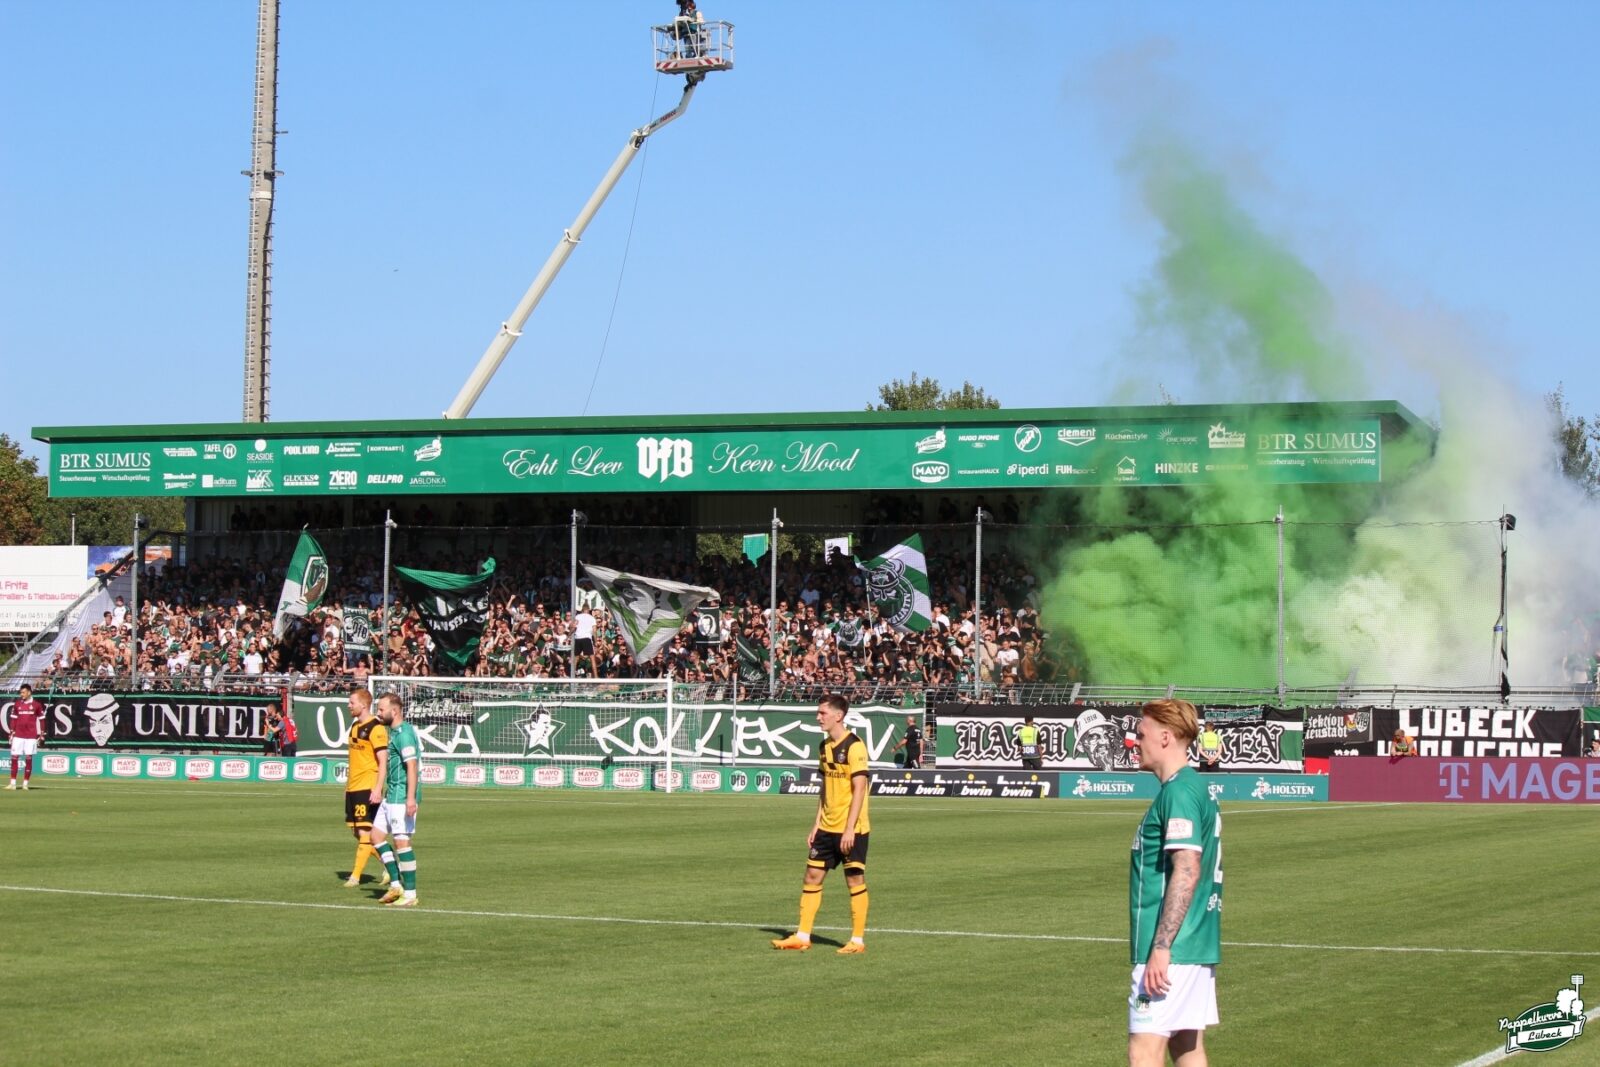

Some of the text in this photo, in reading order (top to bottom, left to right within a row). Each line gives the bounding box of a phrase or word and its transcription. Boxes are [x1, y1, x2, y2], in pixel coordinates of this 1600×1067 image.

[1257, 434, 1297, 450] BTR
[1303, 432, 1376, 450] SUMUS
[60, 454, 91, 468] BTR
[95, 452, 151, 468] SUMUS
[708, 442, 776, 474] Keen
[502, 449, 558, 479] Echt
[915, 466, 946, 475] MAYO
[1018, 463, 1049, 478] iperdi
[409, 477, 446, 485] JABLONKA
[788, 782, 821, 793] bwin
[877, 783, 909, 794] bwin
[915, 784, 946, 795] bwin
[960, 785, 993, 796] bwin
[1000, 786, 1033, 797] bwin
[1093, 783, 1135, 792] HOLSTEN
[1273, 785, 1315, 795] HOLSTEN
[355, 804, 367, 818] 28
